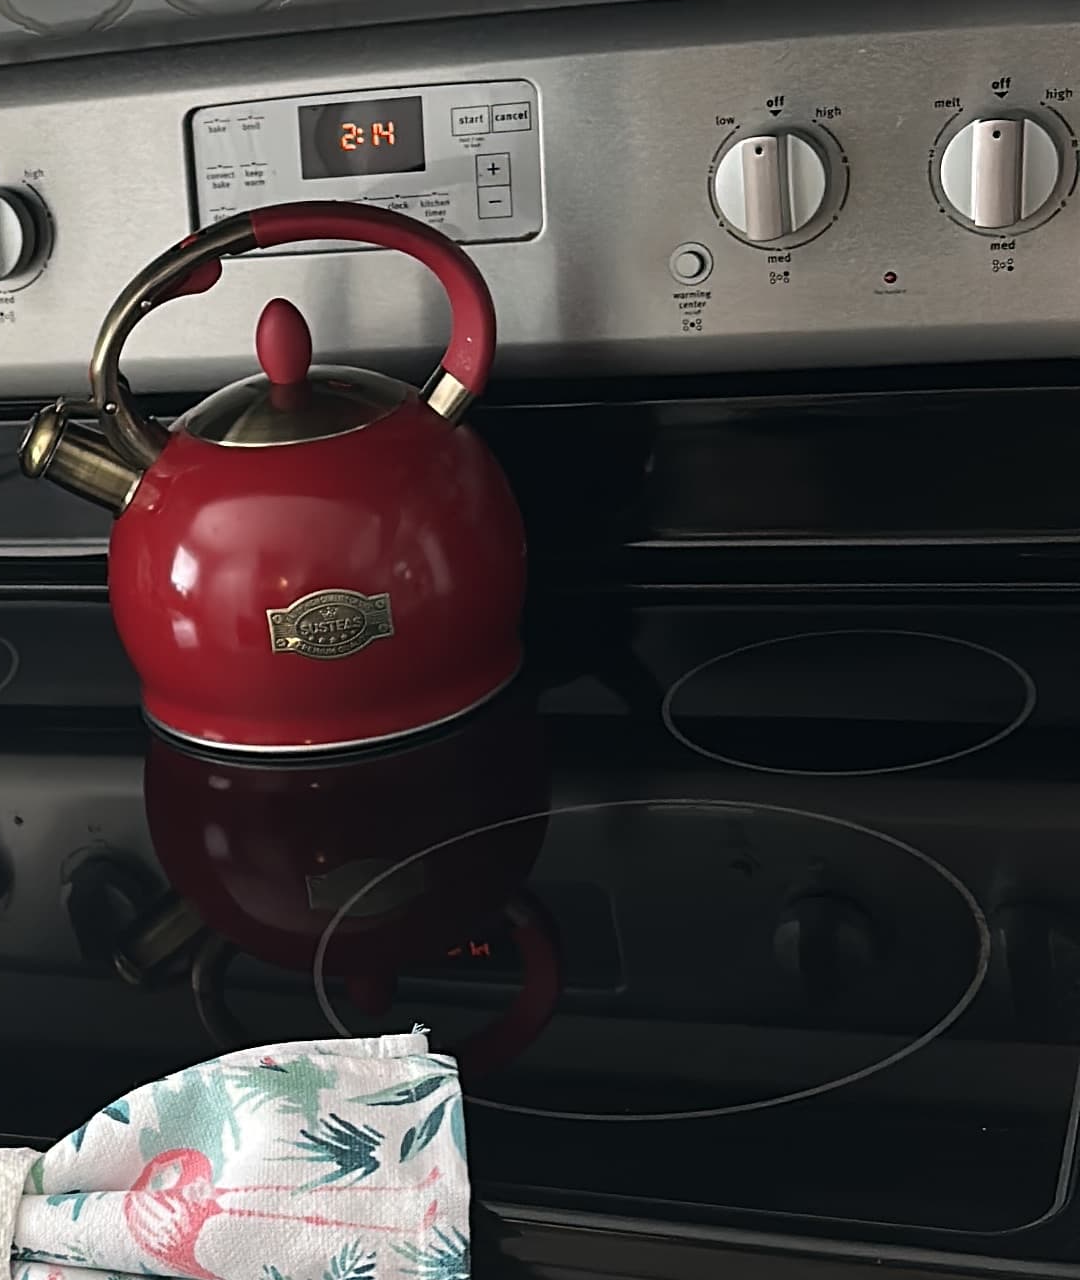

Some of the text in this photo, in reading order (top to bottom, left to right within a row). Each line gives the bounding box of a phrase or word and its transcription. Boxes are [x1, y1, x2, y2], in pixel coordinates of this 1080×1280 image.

[991, 77, 1012, 90] off
[1046, 88, 1073, 101] high
[766, 95, 785, 108] off
[495, 110, 528, 121] cancel
[815, 106, 842, 119] high
[459, 114, 484, 125] start
[715, 115, 735, 126] low
[340, 121, 394, 151] 2:14
[24, 169, 45, 180] high
[990, 240, 1016, 250] med
[767, 253, 792, 264] med
[300, 616, 361, 636] SUSTEAS
